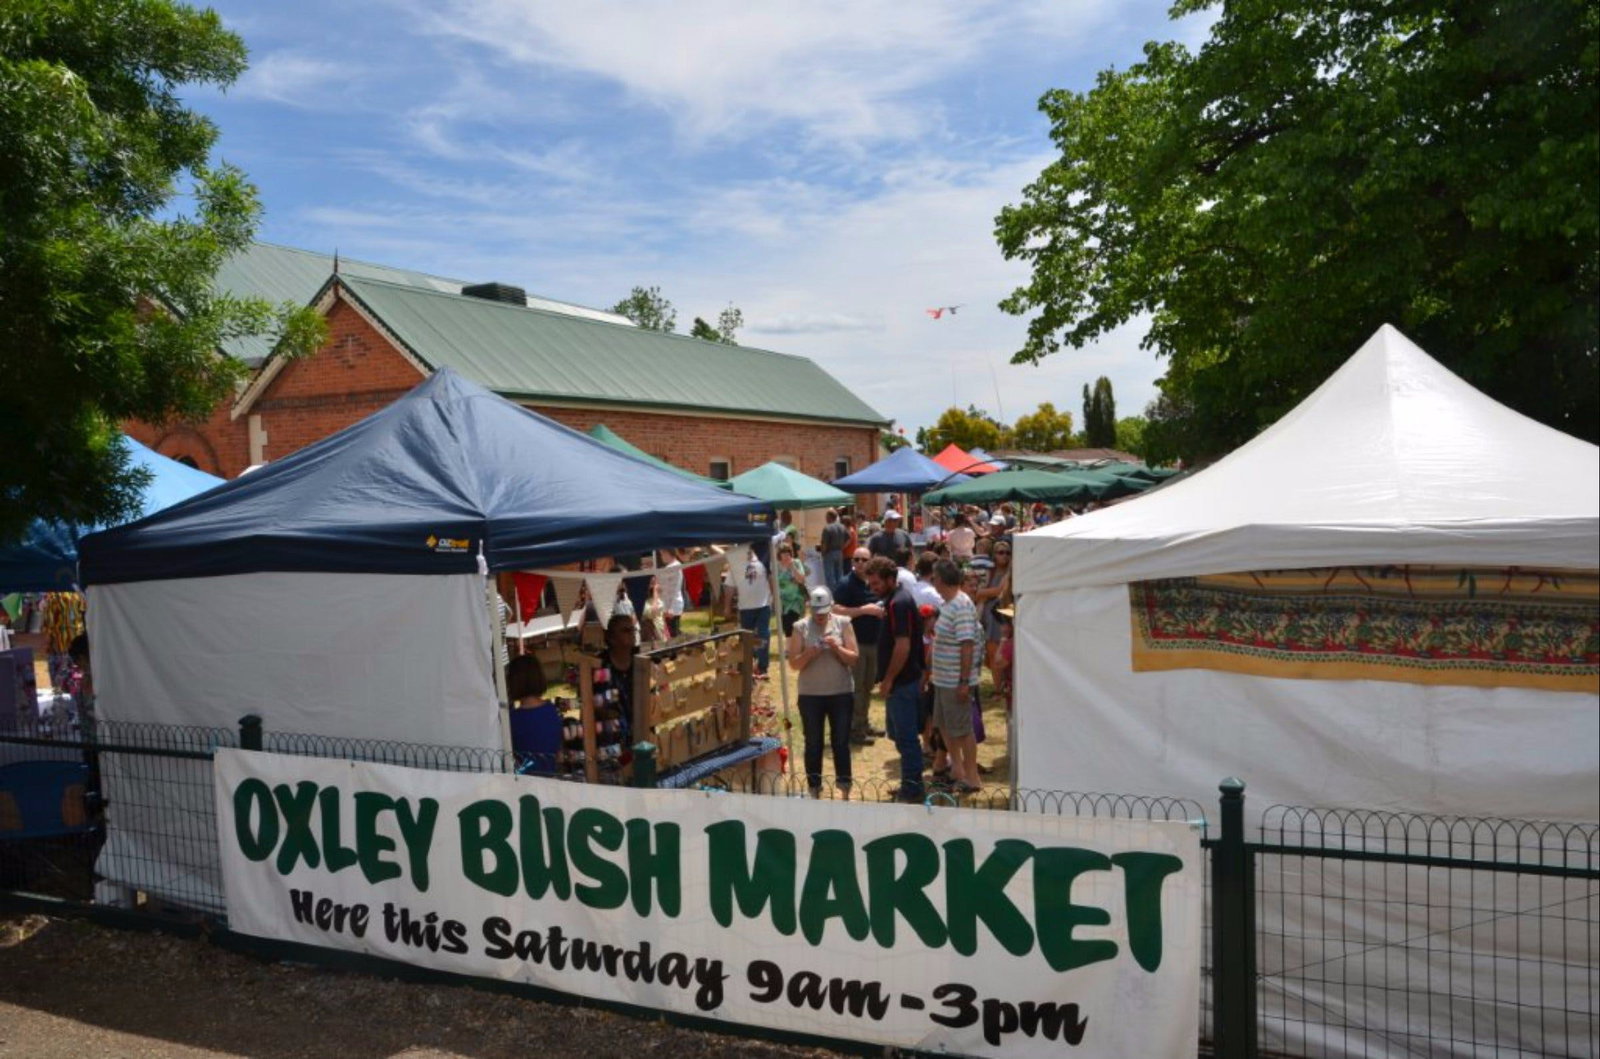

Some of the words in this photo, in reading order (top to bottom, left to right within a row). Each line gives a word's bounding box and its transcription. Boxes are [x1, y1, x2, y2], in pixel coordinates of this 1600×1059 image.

[233, 777, 439, 893] OXLEY
[457, 794, 682, 918] BUSH
[703, 819, 1184, 974] MARKET
[289, 888, 370, 939] Here
[382, 902, 469, 955] this
[482, 916, 730, 1011] Saturday
